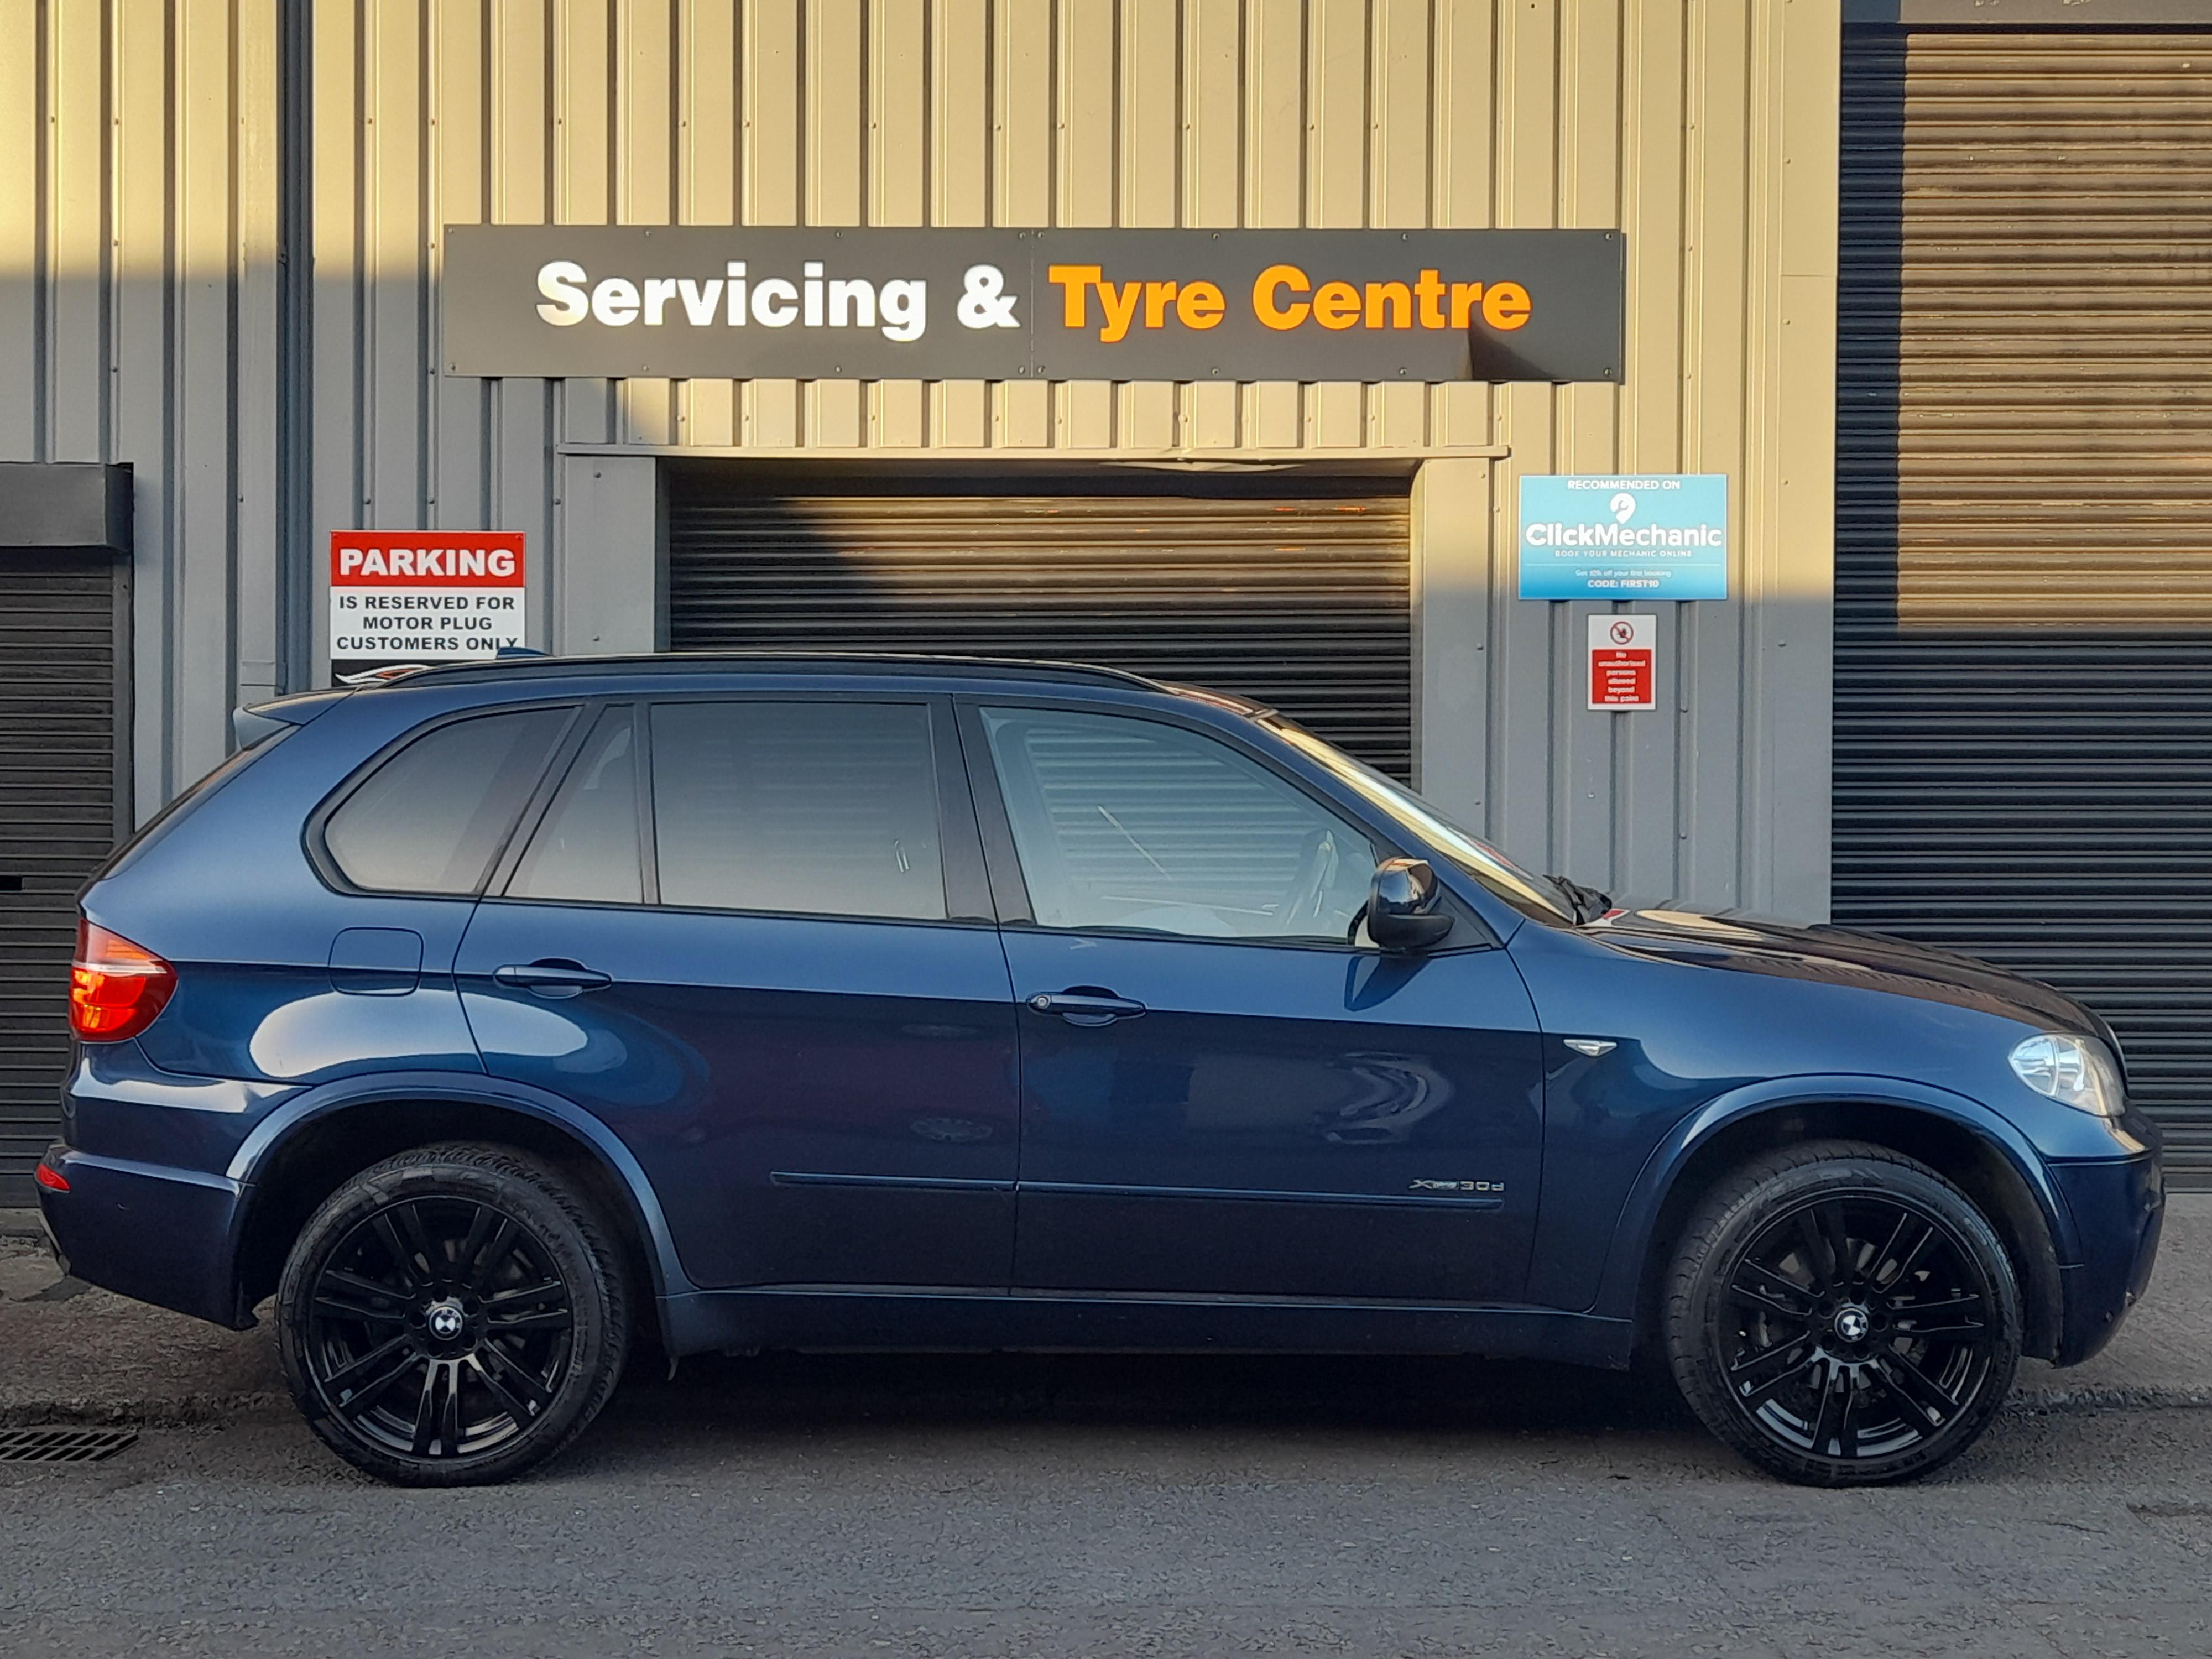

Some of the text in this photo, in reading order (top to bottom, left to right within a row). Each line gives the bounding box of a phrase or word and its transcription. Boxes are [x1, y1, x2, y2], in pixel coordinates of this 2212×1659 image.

[536, 261, 1531, 342] Servicing & Tyre Centre
[1567, 480, 1681, 490] RECOMMENDED ON
[1526, 523, 1722, 546] ClickMechanic
[340, 549, 515, 577] PARKING
[1587, 580, 1618, 588] CODE:
[340, 596, 514, 609] IS RESERVED FOR
[363, 617, 492, 630] MOTOR PLUG
[337, 637, 458, 650] CUSTOMERS
